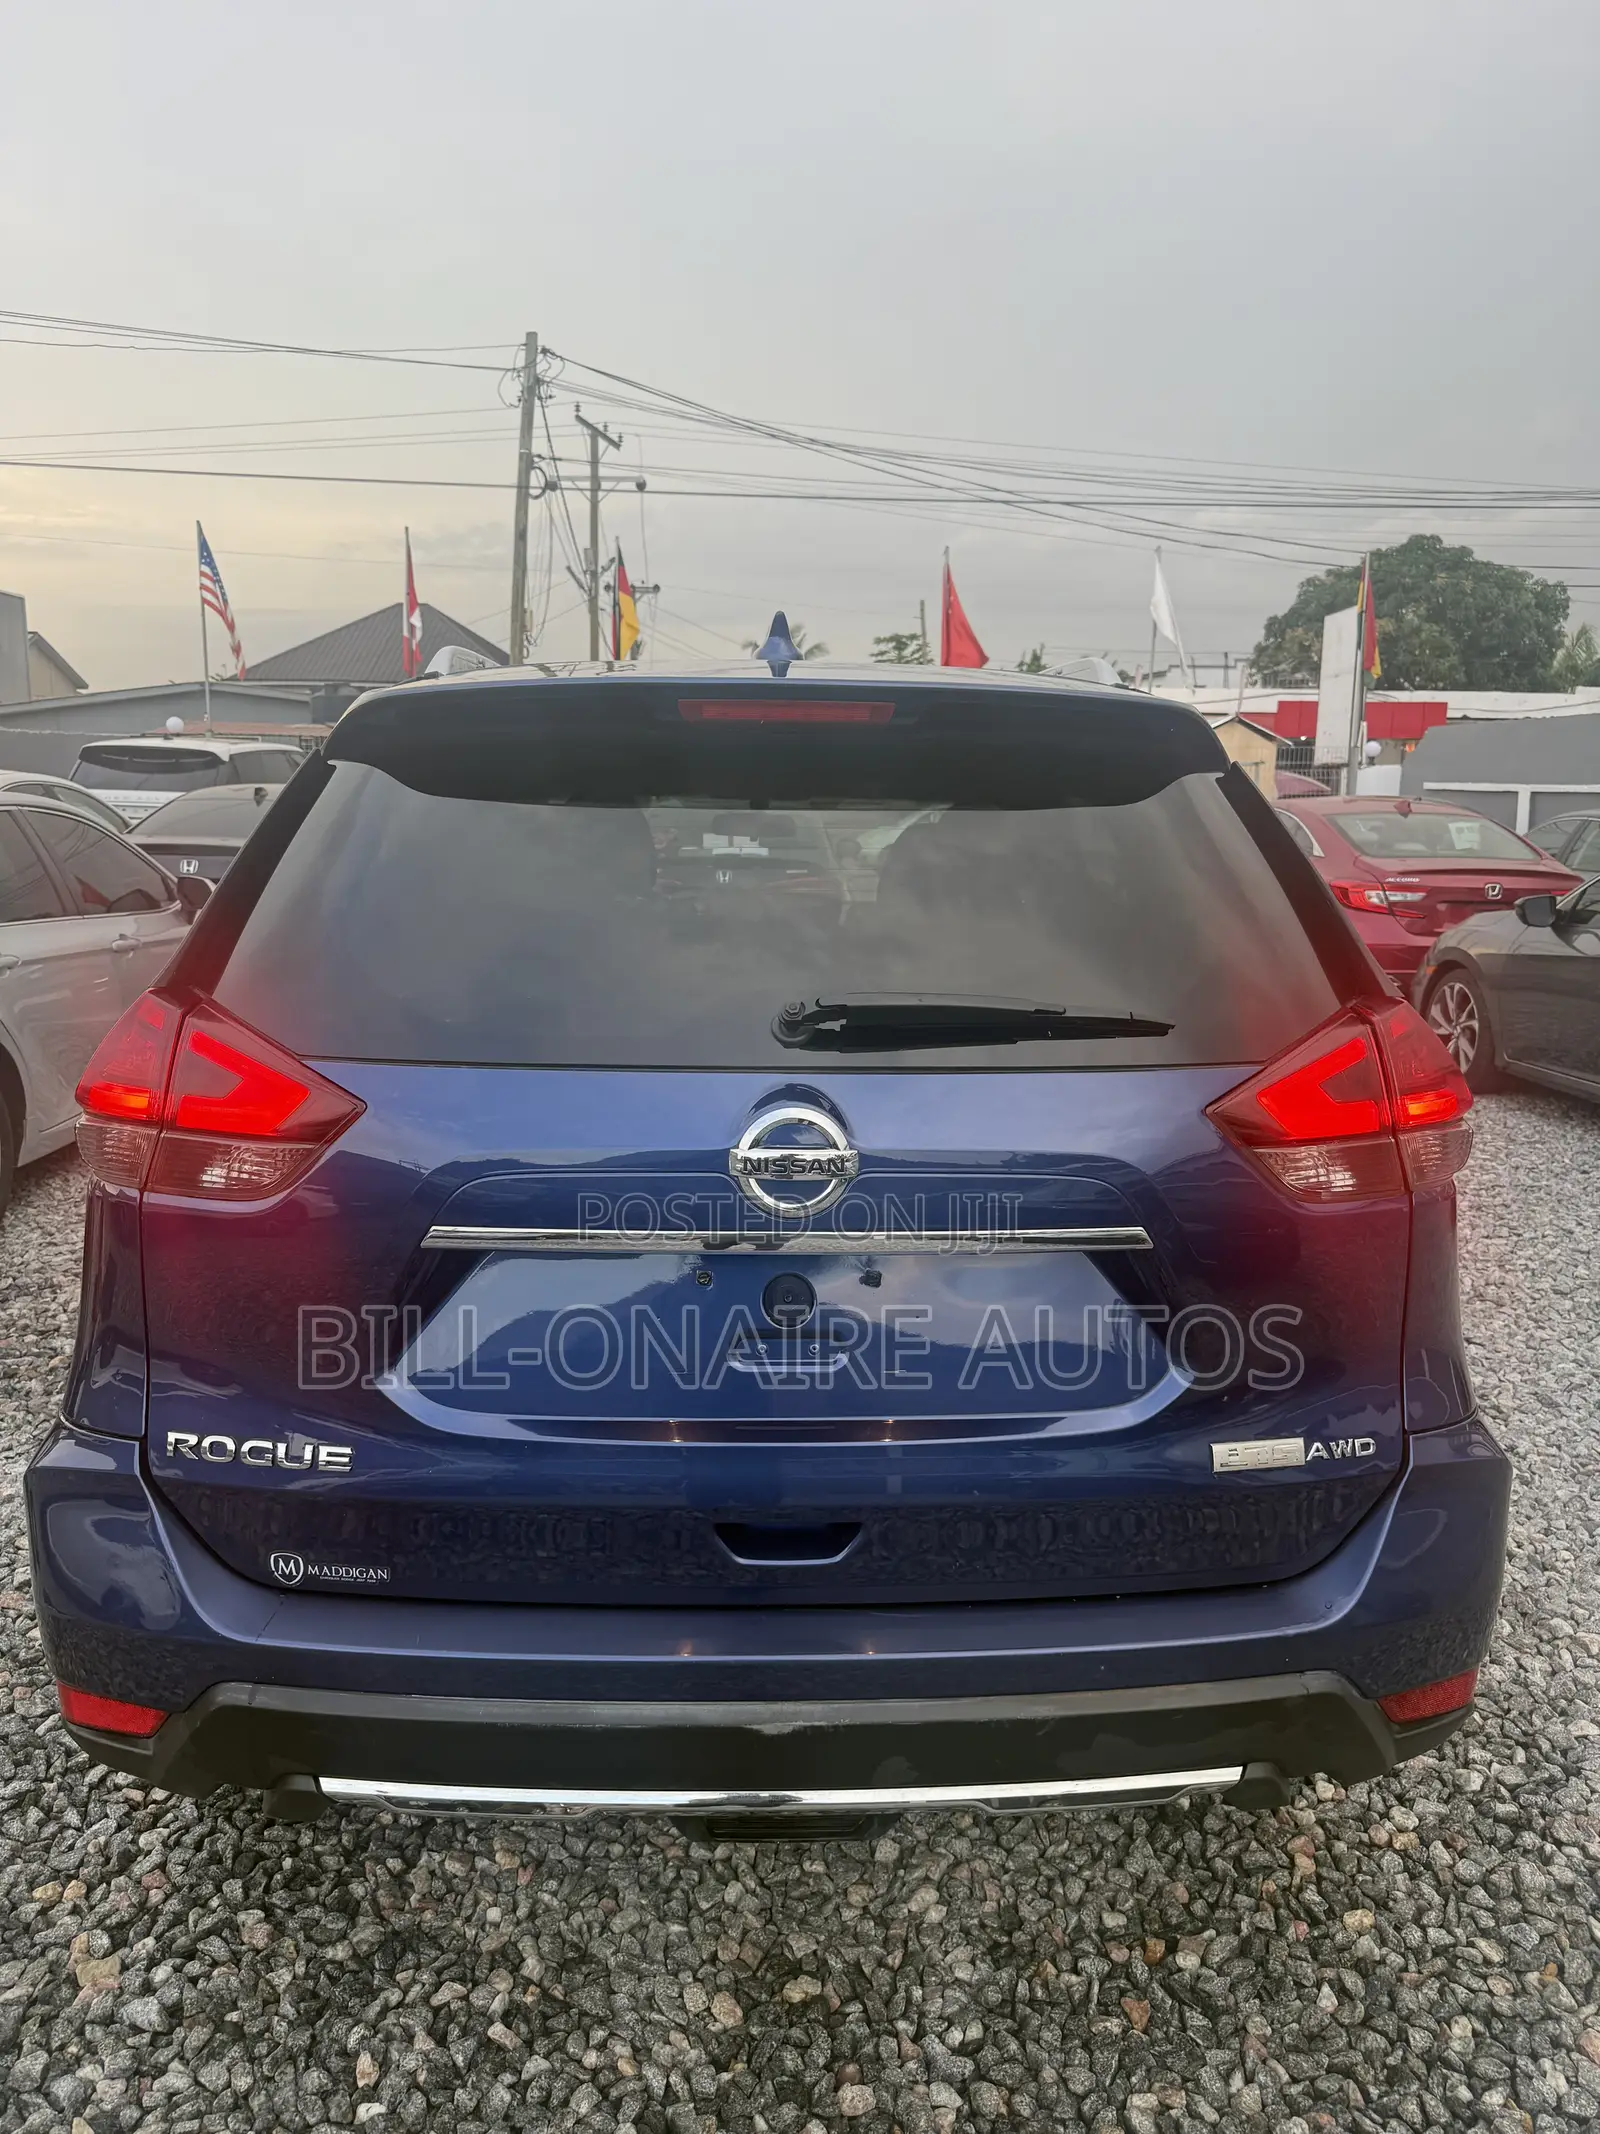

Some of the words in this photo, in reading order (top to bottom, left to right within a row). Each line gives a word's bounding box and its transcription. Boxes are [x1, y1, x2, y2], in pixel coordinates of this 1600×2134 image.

[743, 1157, 845, 1175] NISSAN
[166, 1431, 354, 1472] ROGUE
[1306, 1437, 1377, 1461] AWD
[307, 1564, 389, 1580] MADDIGAN
